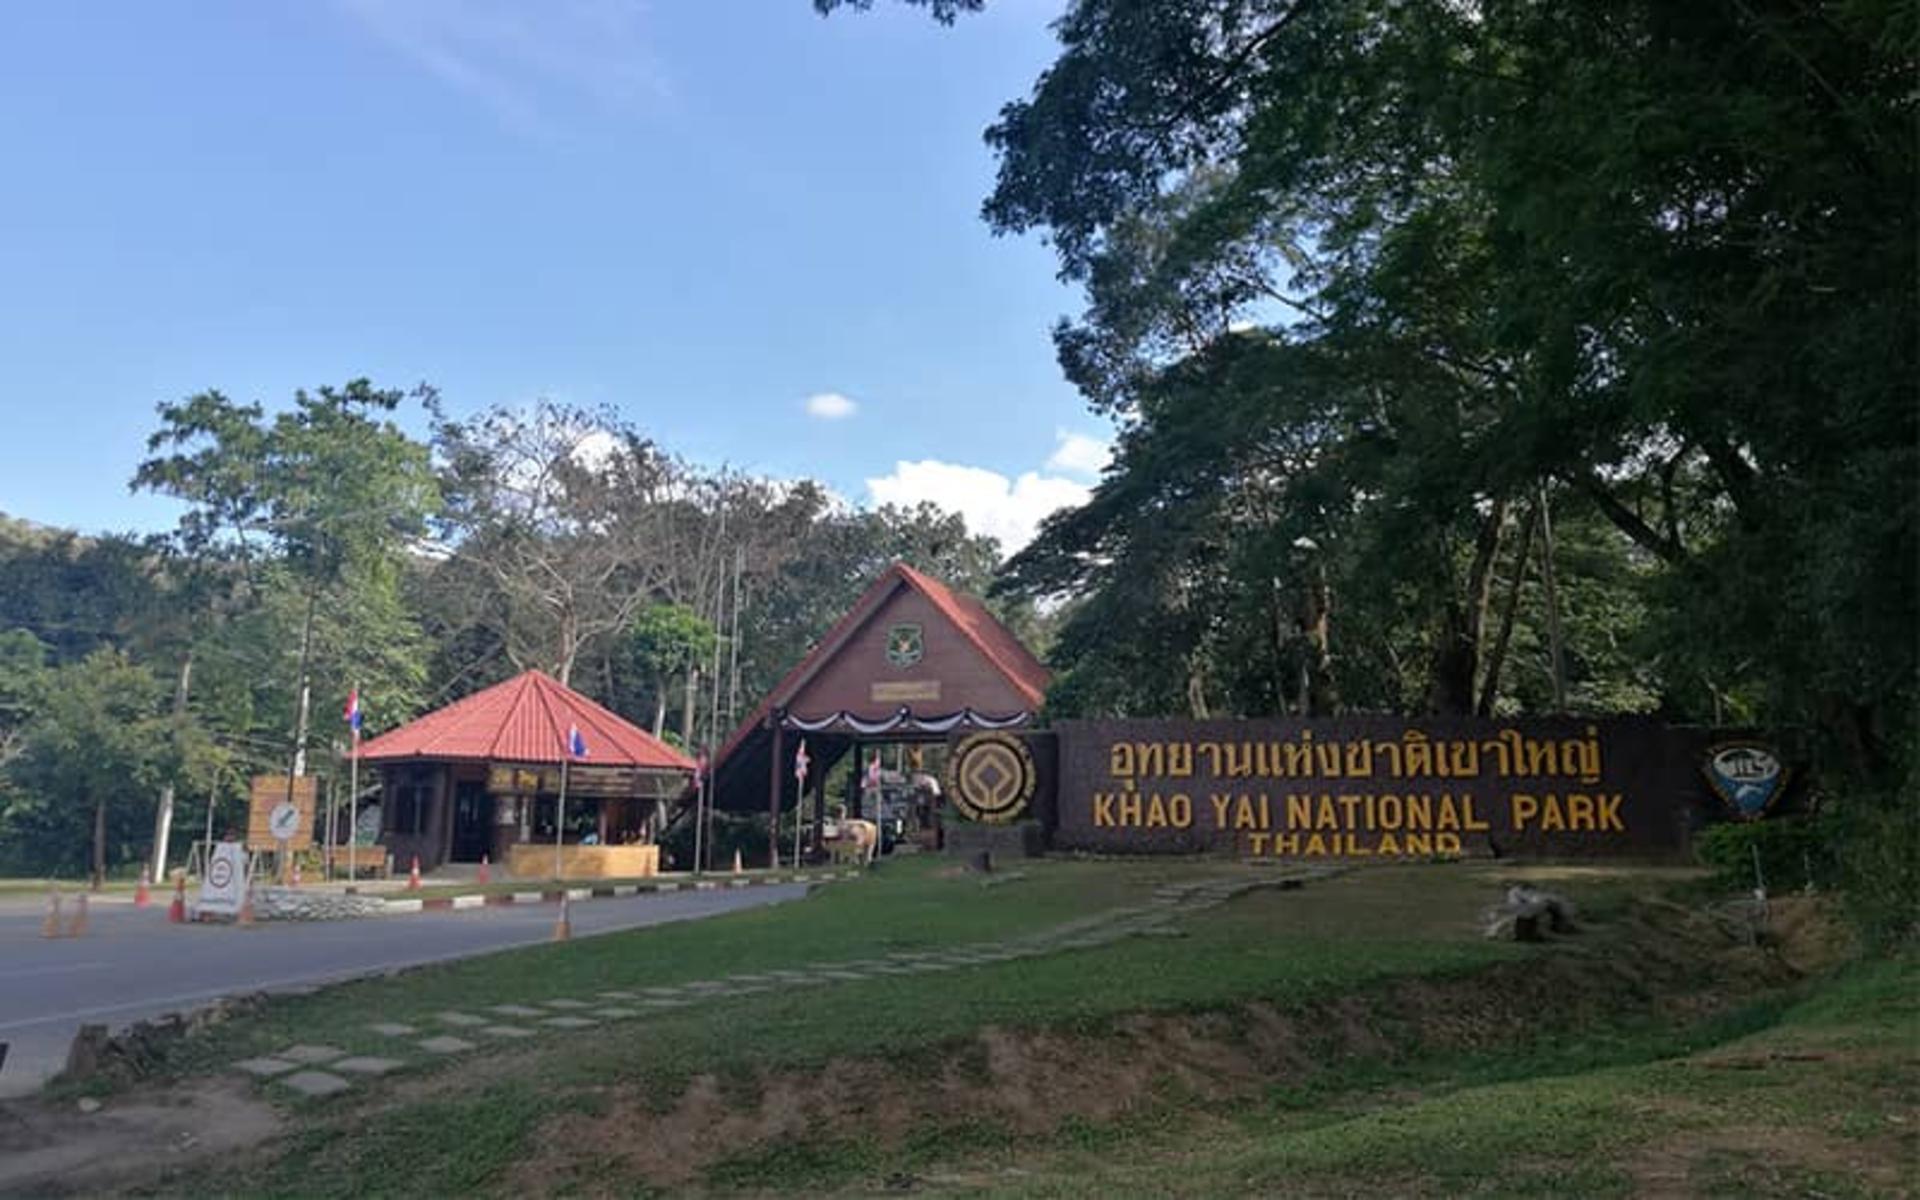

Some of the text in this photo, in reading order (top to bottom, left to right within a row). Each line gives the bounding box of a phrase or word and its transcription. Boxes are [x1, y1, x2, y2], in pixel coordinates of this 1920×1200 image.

[1111, 726, 1601, 791] อุทยานแห่งชาติเขาใหญ่
[1093, 793, 1625, 831] KHAO YAI NATIONAL PARK
[1249, 832, 1462, 855] THAILAND
